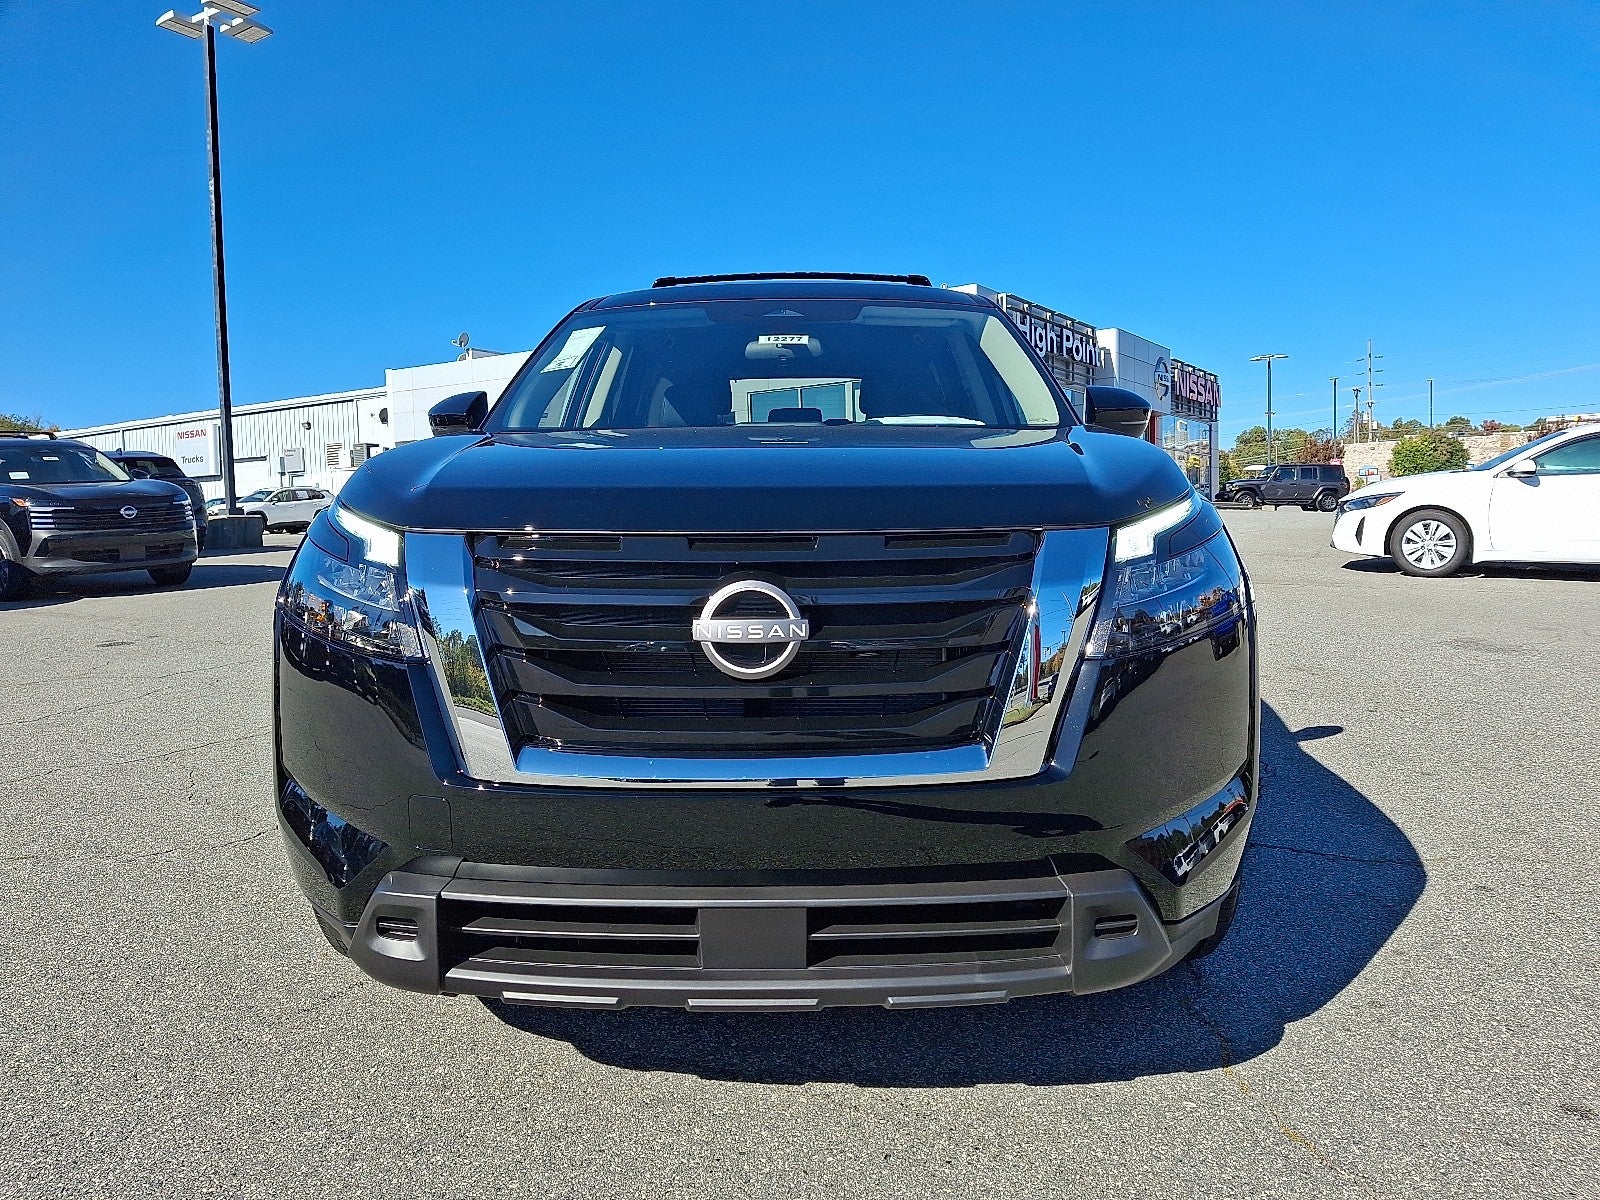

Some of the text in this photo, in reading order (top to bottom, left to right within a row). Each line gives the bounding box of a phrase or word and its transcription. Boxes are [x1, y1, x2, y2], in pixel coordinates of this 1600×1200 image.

[1016, 312, 1100, 367] High Point
[1176, 370, 1219, 407] NISSAN
[177, 429, 207, 440] NISSAN
[181, 455, 204, 464] Trucks
[696, 623, 806, 639] NISSAN
